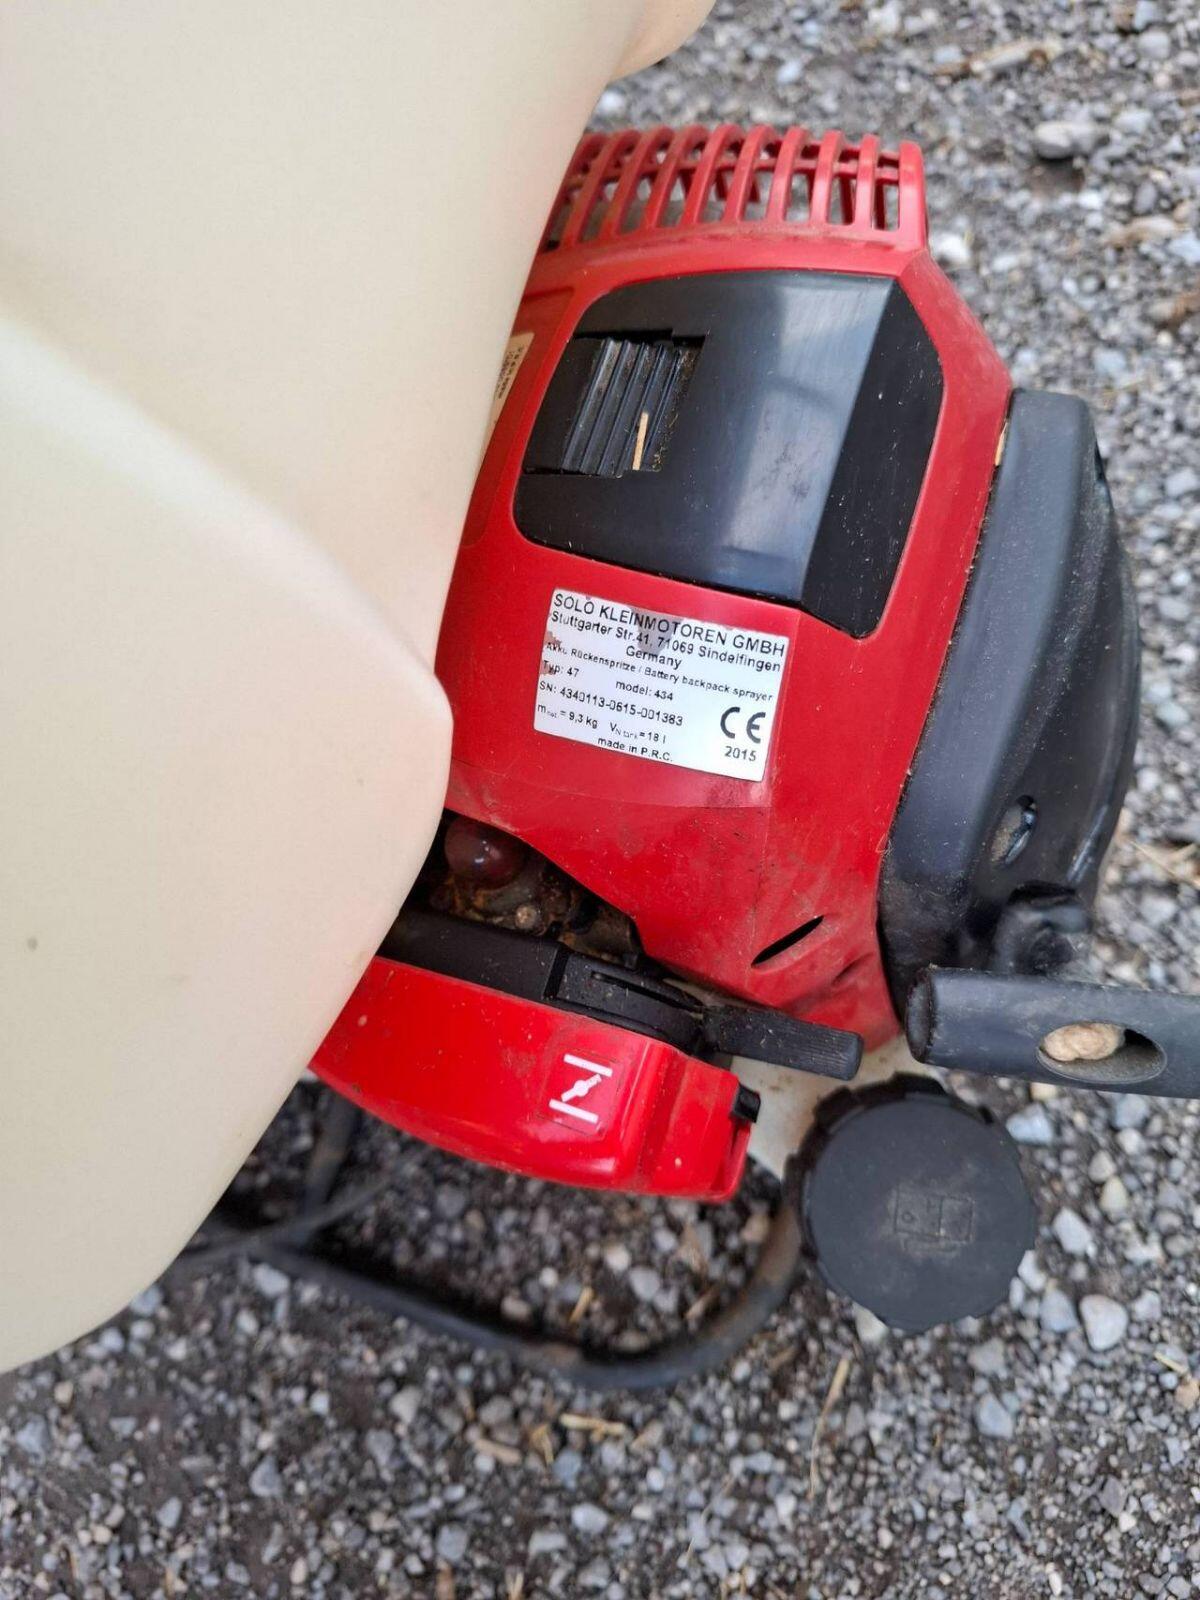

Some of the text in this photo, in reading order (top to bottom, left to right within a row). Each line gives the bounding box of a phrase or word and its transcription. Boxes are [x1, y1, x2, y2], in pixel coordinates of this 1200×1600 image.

[553, 593, 785, 657] SOLO KLEINMOTOREN GMBH
[551, 610, 612, 635] Stuttgarter
[657, 636, 694, 654] 71069
[698, 645, 781, 672] Sindelfingen
[625, 645, 682, 670] Germany
[567, 667, 579, 678] 47
[571, 648, 636, 673] Rückenspritze
[644, 667, 679, 685] Battery
[682, 675, 730, 694] backpack
[732, 687, 773, 702] sprayer
[539, 680, 683, 726] SN: 4340113-0615-001383
[615, 681, 673, 701] model: 434
[569, 711, 584, 723] 9,3
[586, 716, 598, 729] kg
[597, 737, 673, 762] made in P.R.C.
[724, 745, 757, 762] 2015
